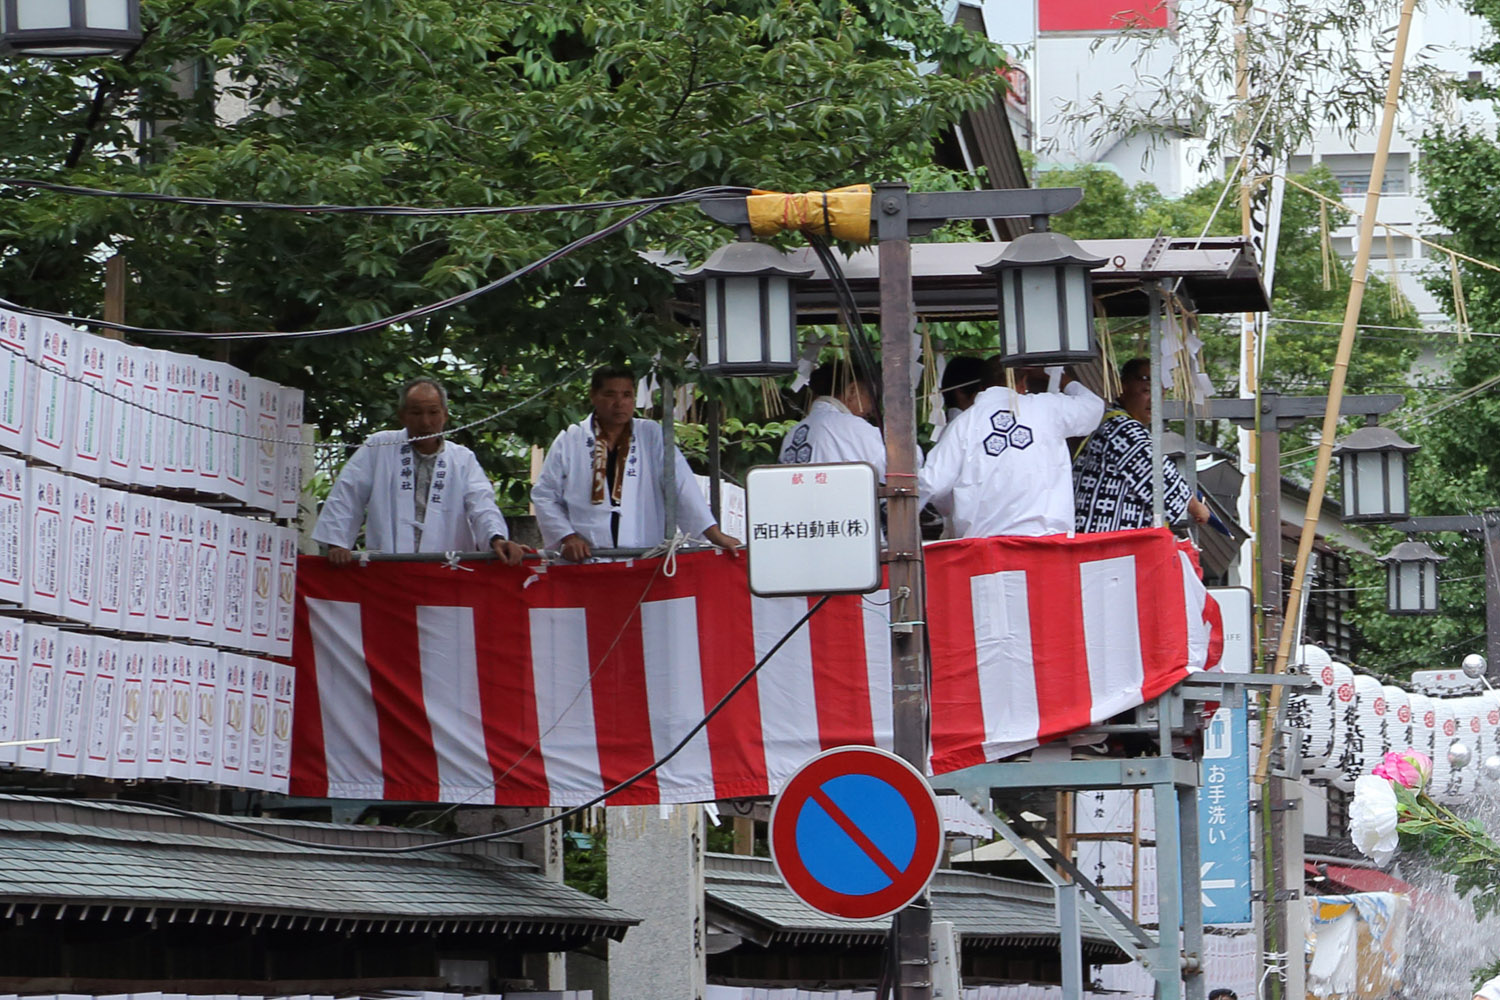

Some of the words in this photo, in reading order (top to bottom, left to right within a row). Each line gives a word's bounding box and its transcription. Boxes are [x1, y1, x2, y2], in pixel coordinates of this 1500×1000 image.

[753, 519, 870, 540] 西日本自動車(株)
[1207, 764, 1227, 845] お手洗い
